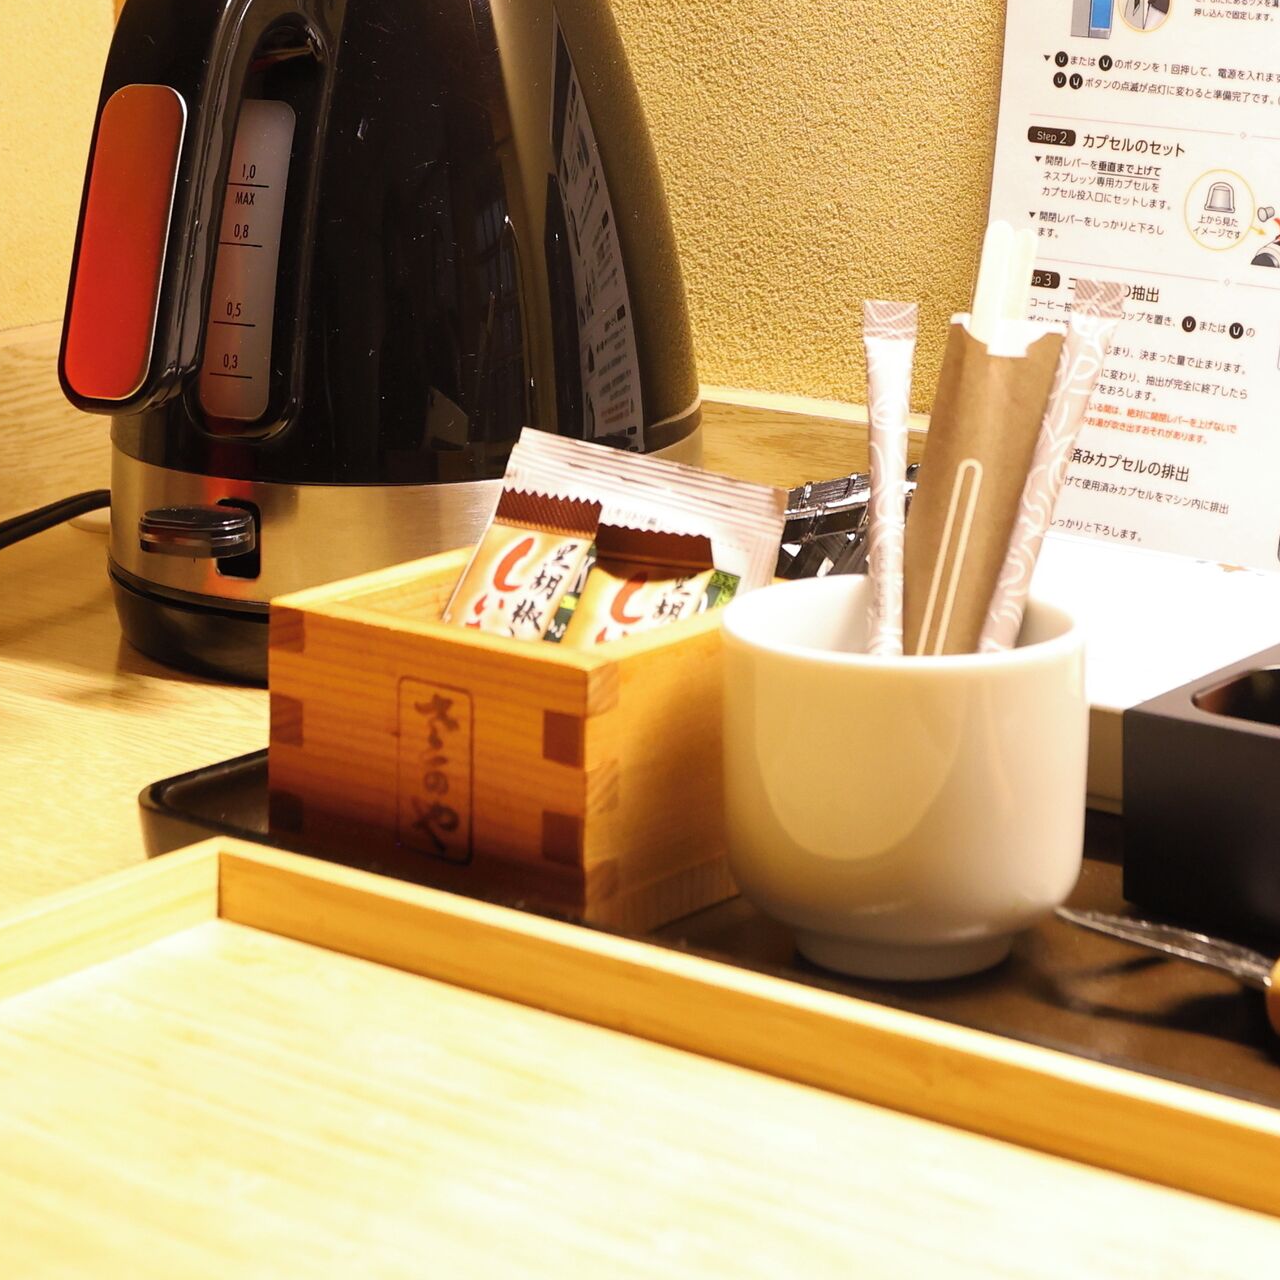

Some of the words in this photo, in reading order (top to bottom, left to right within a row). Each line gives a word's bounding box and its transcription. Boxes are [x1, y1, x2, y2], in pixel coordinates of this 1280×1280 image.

[1070, 55, 1096, 67] または
[1036, 130, 1057, 143] Step
[1060, 131, 1067, 145] 2
[1083, 134, 1185, 157] カプセルのセット
[1043, 170, 1160, 193] ネスプレッソ専用カプセルを
[235, 192, 256, 206] MAX
[1041, 186, 1172, 211] カプセル投入口にセットします。
[1039, 211, 1165, 236] 開閉レバーをしっかりと下ろし
[1037, 226, 1059, 239] ます。
[1043, 273, 1052, 287] 3
[1199, 321, 1226, 334] または
[1246, 328, 1256, 338] の
